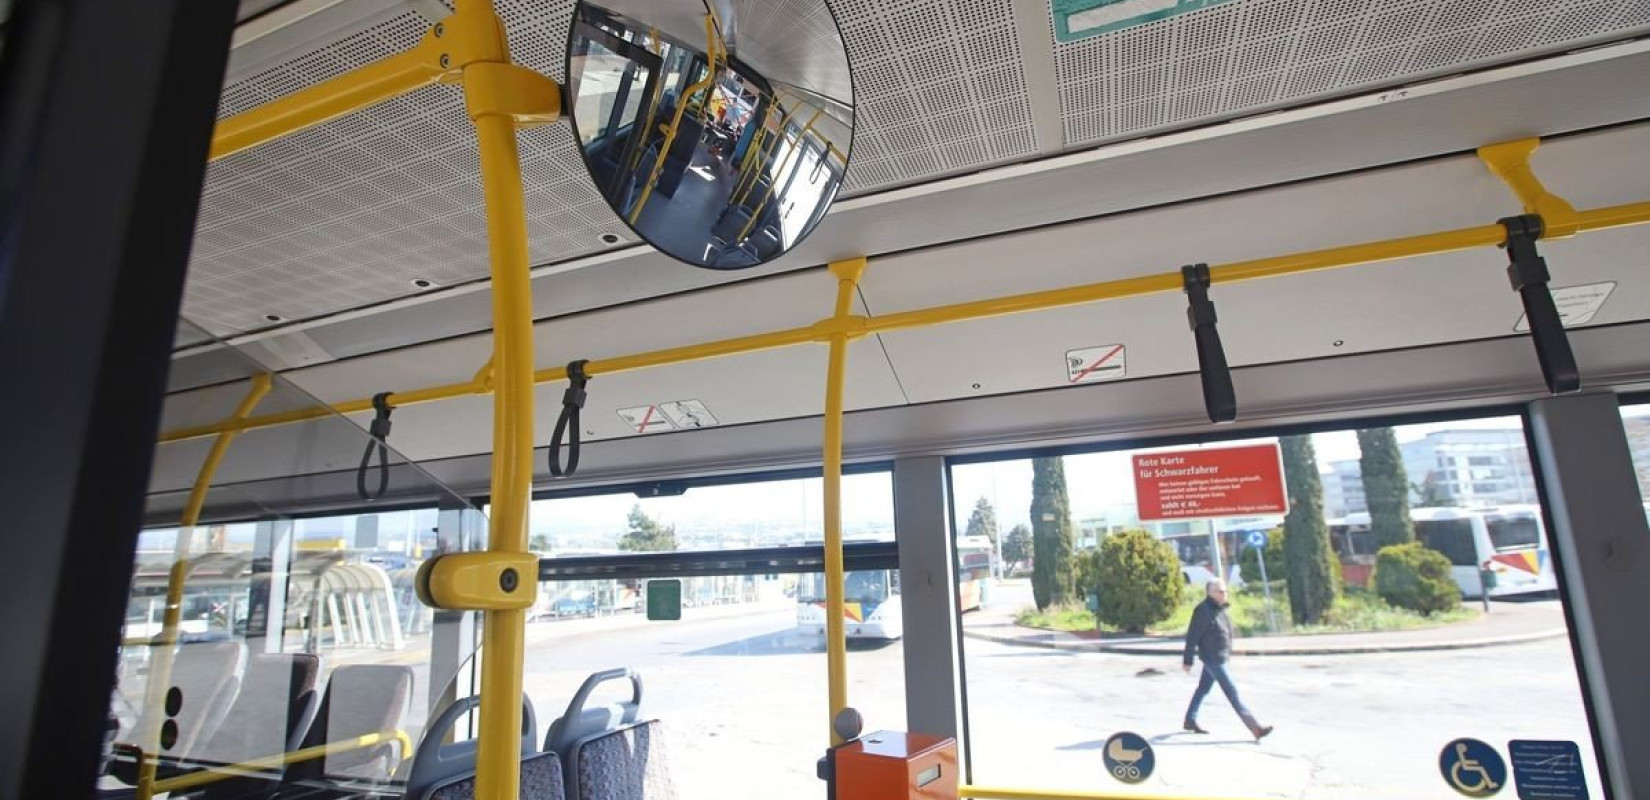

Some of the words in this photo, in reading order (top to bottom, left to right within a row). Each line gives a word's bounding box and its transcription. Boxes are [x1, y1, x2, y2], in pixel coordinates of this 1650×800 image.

[1138, 458, 1159, 467] Rote
[1160, 456, 1185, 465] Karte
[1140, 469, 1152, 478] für
[1154, 465, 1220, 478] Schwarzfahrer
